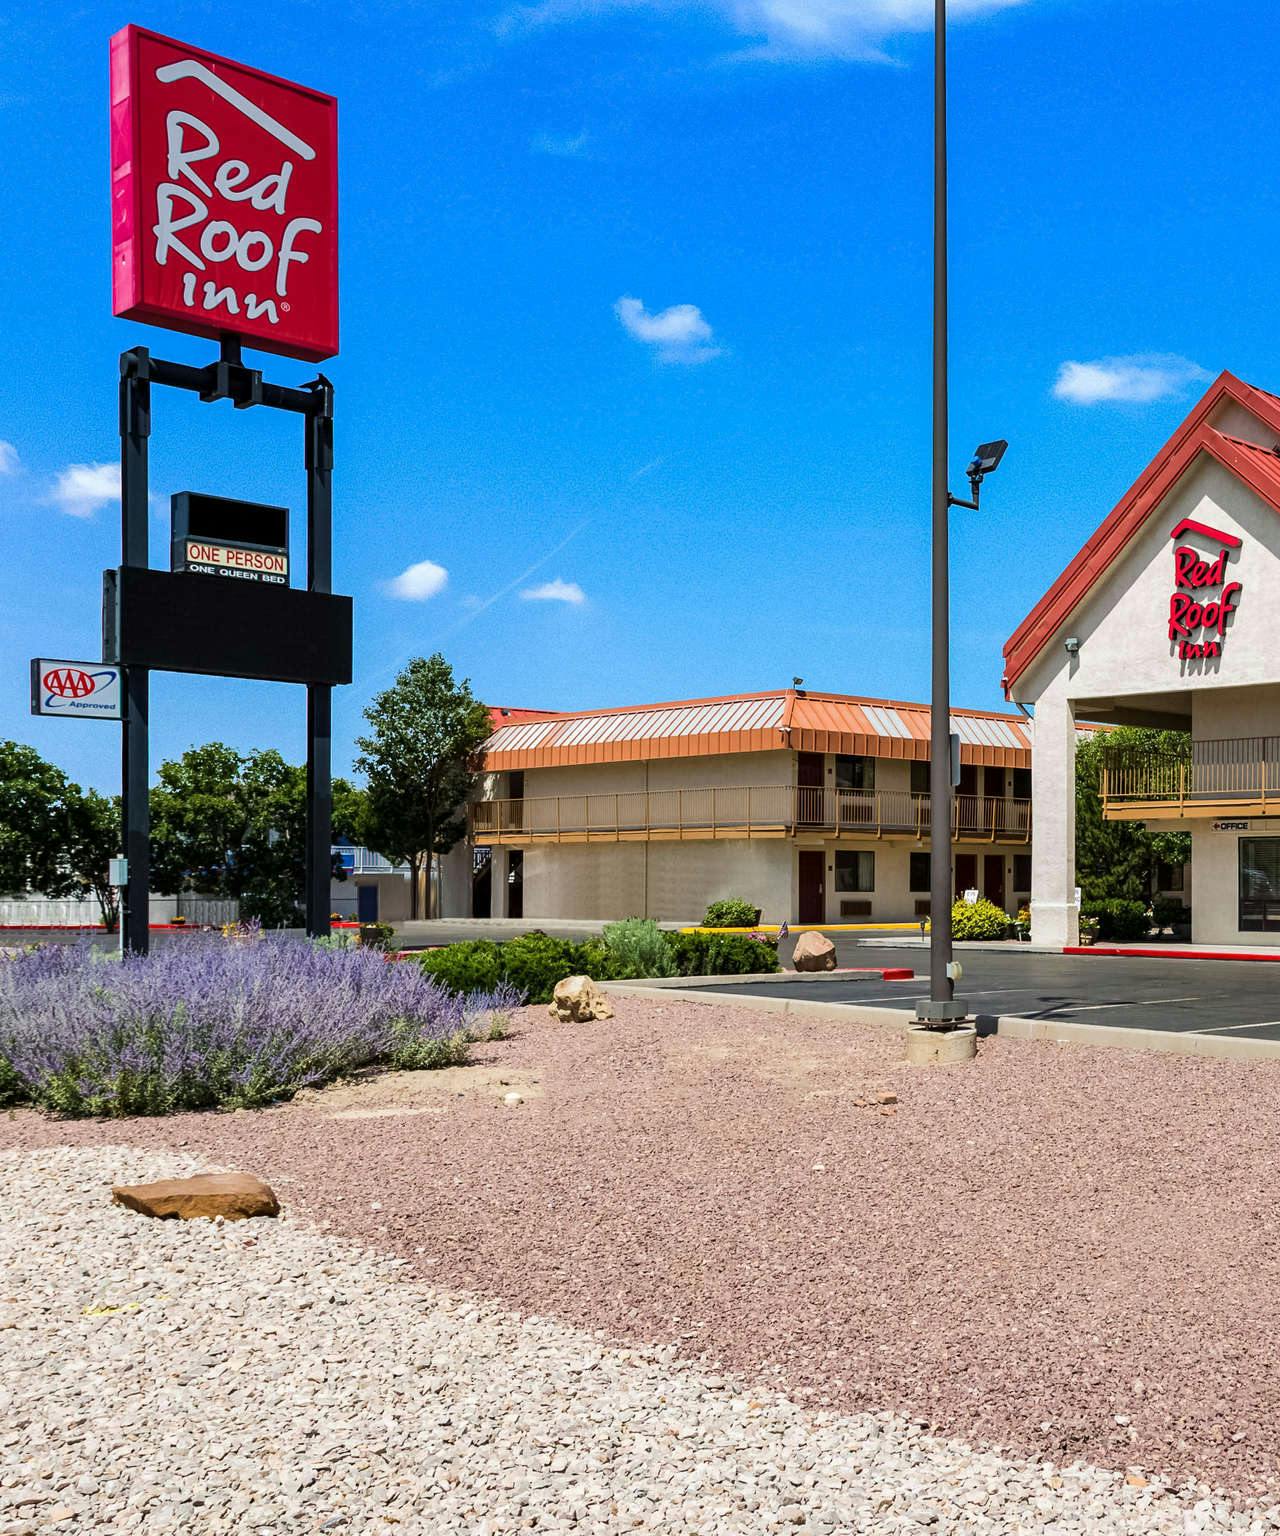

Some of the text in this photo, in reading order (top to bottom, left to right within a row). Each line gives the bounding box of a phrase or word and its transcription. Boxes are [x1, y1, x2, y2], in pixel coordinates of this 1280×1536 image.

[166, 110, 293, 215] Red
[152, 182, 323, 297] Roof
[189, 544, 284, 572] ONE PERSON
[1175, 546, 1229, 589] Red
[189, 564, 285, 584] ONE QUEEN BED
[1168, 582, 1243, 640] Roof
[46, 668, 93, 698] AAA
[69, 701, 116, 710] Approved
[1220, 822, 1249, 830] OFFICE
